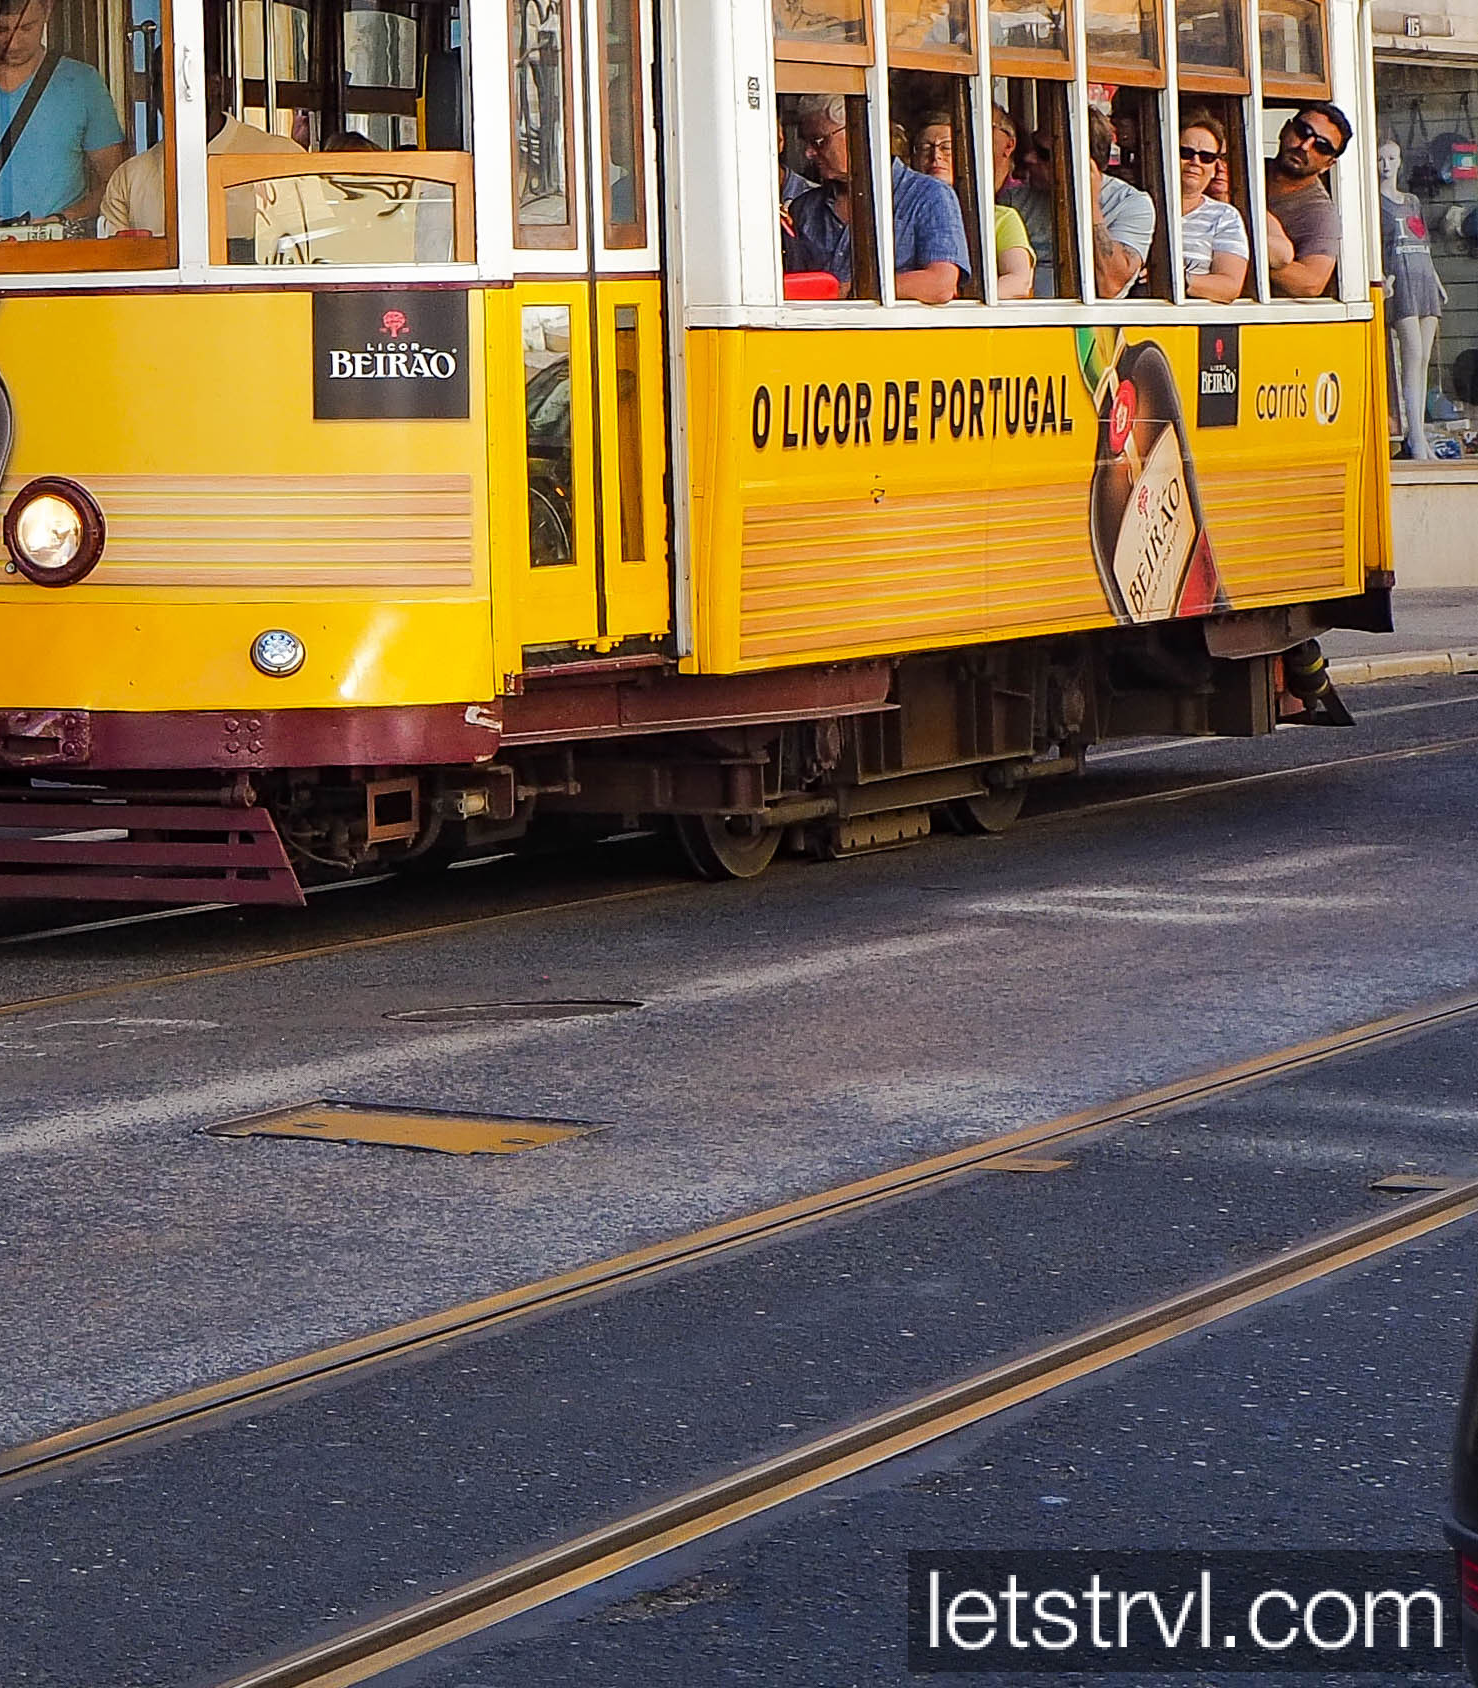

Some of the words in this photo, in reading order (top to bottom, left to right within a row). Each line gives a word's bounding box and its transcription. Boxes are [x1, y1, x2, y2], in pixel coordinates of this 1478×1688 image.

[366, 342, 421, 352] LICOR
[329, 348, 457, 379] BEIRÃO
[1201, 368, 1237, 394] BEIRÃO
[1256, 368, 1308, 420] carris
[752, 384, 773, 450] O
[782, 381, 872, 449] LICOR
[883, 379, 920, 444] DE
[930, 374, 1073, 439] PORTUGAL
